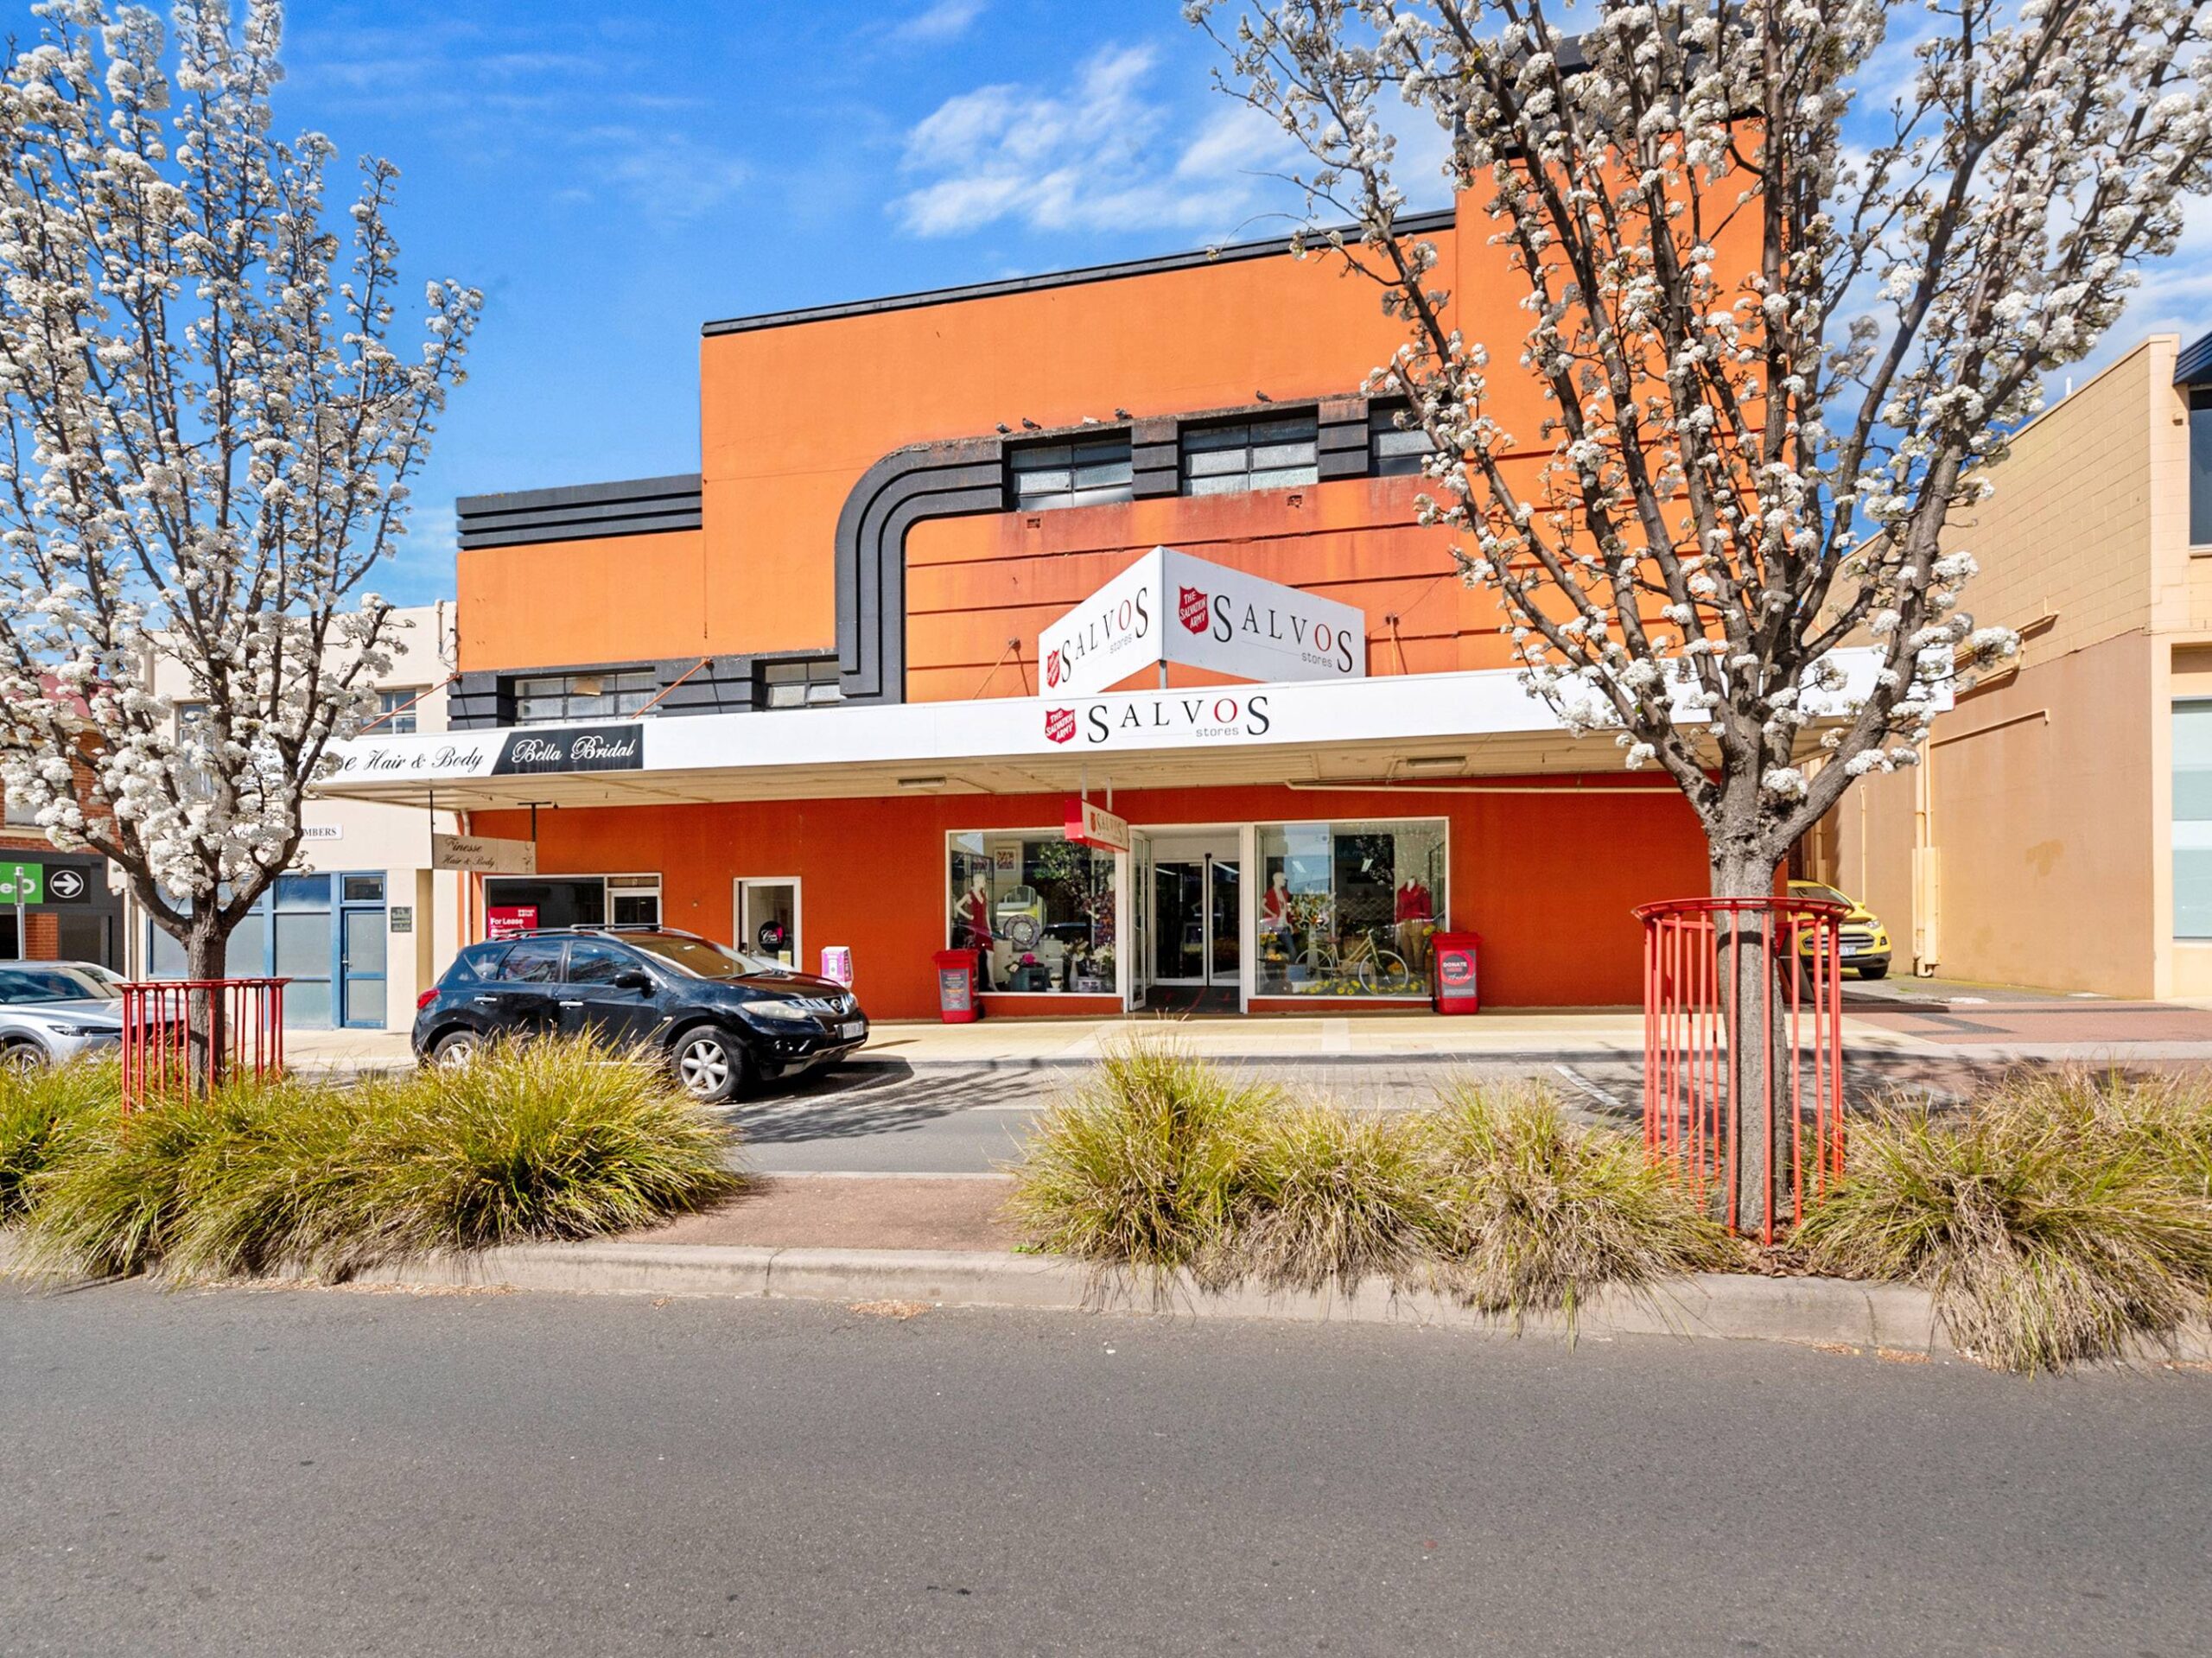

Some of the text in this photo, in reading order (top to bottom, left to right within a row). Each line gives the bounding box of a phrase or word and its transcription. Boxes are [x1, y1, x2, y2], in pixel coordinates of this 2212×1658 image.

[1184, 590, 1198, 605] THE
[1179, 596, 1206, 621] SALVATION
[1190, 609, 1206, 629] ARMY
[1061, 587, 1148, 683] SALVOS
[1213, 594, 1353, 673] SALVOS
[1109, 633, 1132, 654] stores
[1301, 651, 1333, 668] stores
[1046, 711, 1074, 736] SALVATION
[1049, 709, 1064, 724] THE
[1087, 696, 1270, 744] SALVOS
[1056, 722, 1074, 740] ARMY
[1196, 727, 1239, 738] stores
[512, 735, 636, 763] Bella Bridal
[363, 749, 406, 771] Hair
[410, 757, 427, 769] &
[431, 746, 484, 773] Body
[303, 828, 337, 837] MBERS
[445, 837, 482, 852] Finesse
[442, 854, 461, 865] Hair
[473, 855, 495, 868] Body
[491, 917, 502, 925] For
